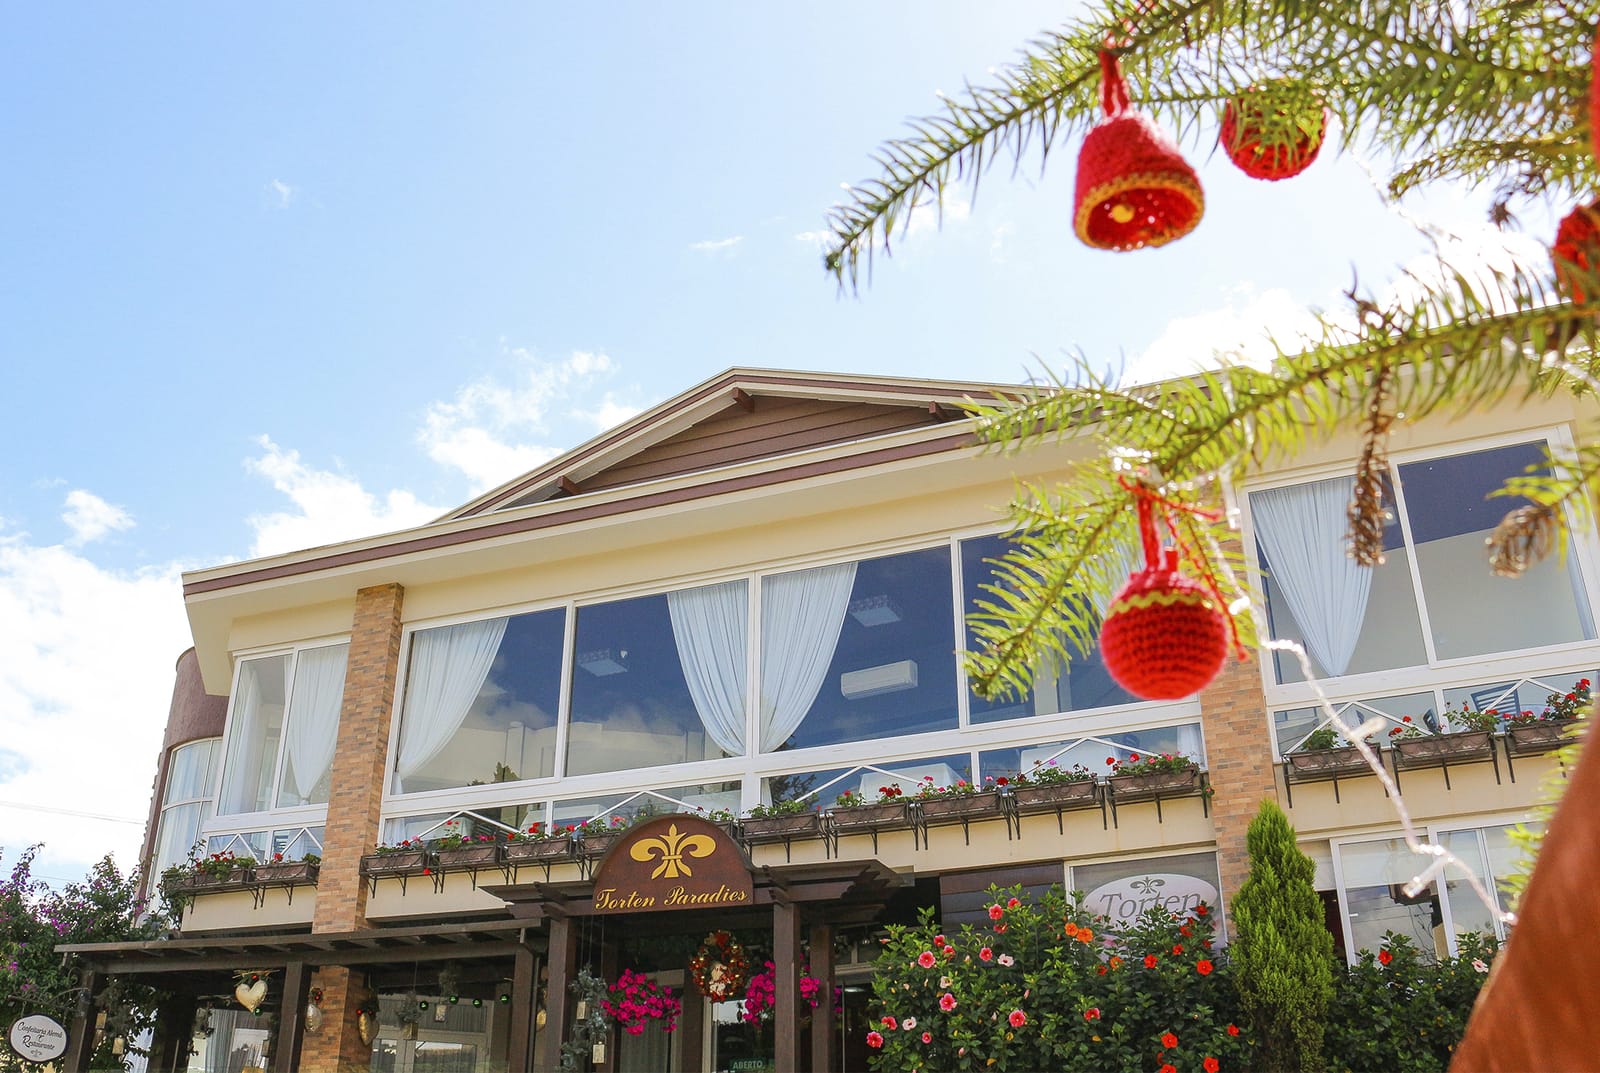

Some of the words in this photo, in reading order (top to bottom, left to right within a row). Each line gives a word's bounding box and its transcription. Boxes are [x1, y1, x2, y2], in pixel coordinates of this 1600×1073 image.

[595, 888, 655, 909] Torten
[664, 884, 748, 905] Paradies
[1099, 891, 1202, 918] Torten
[732, 1060, 763, 1070] ABERTO
